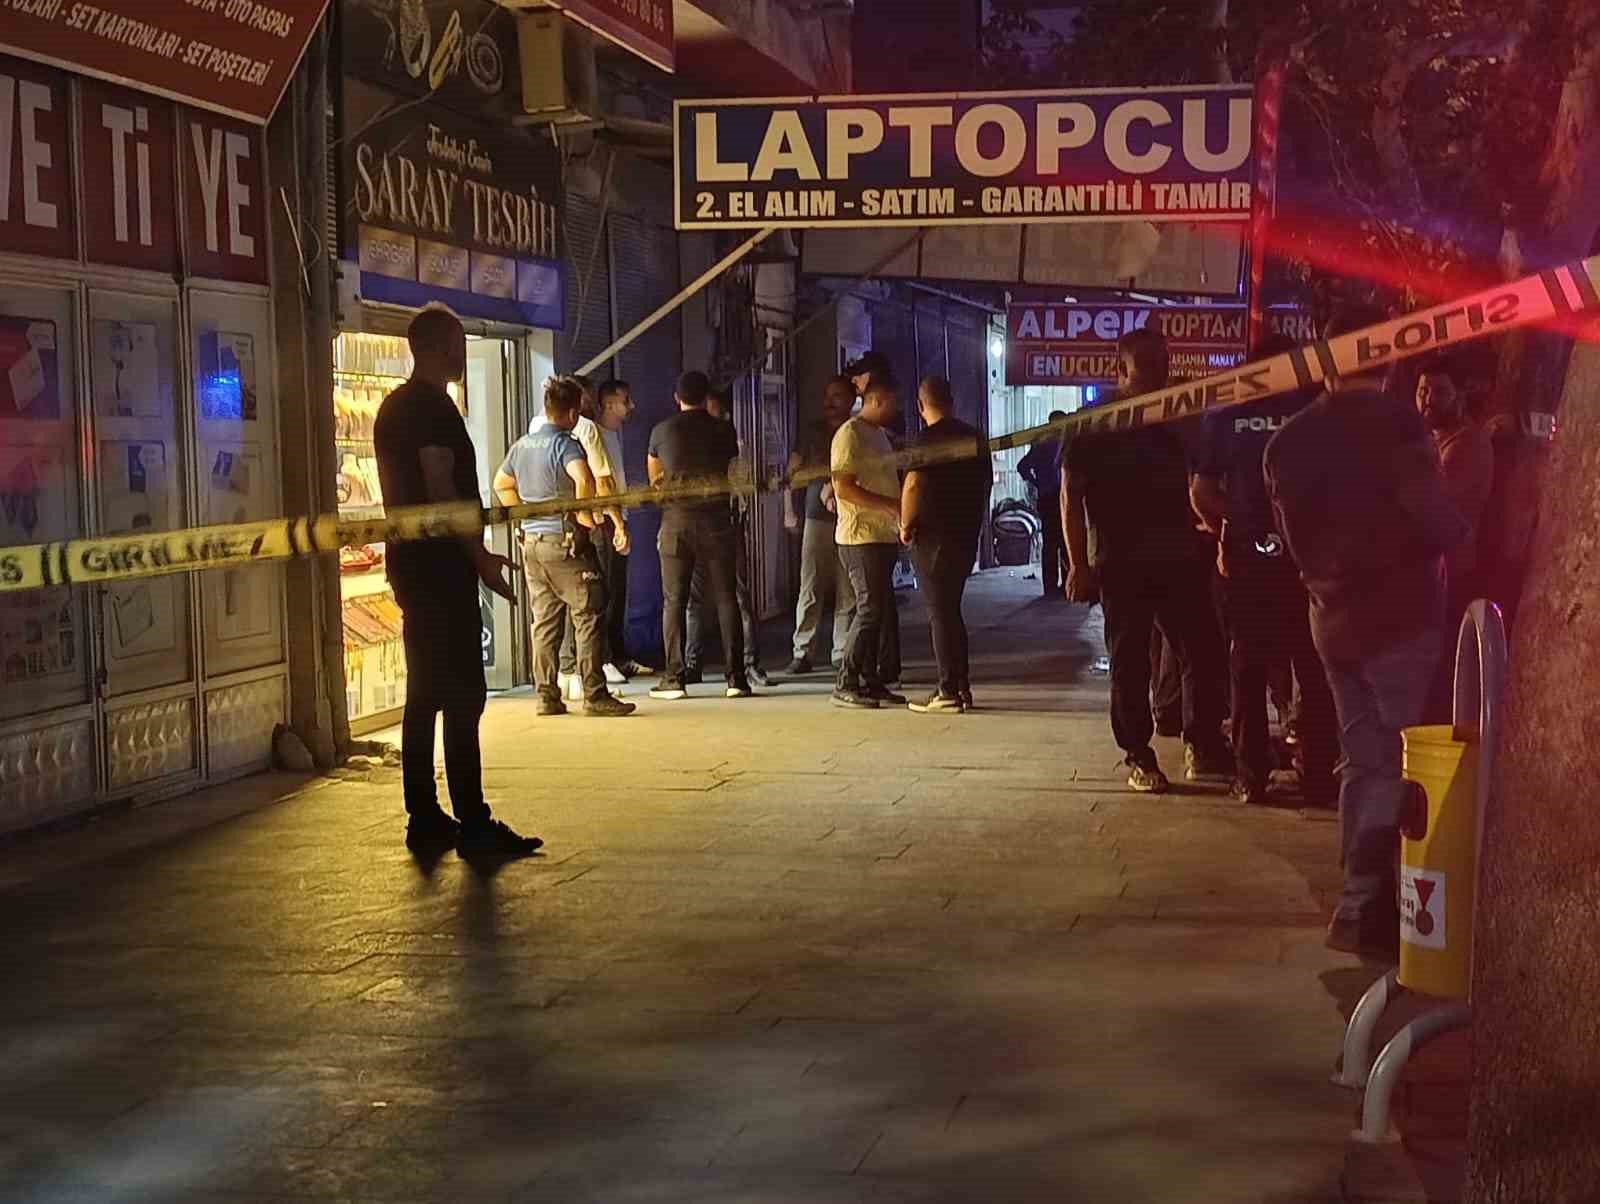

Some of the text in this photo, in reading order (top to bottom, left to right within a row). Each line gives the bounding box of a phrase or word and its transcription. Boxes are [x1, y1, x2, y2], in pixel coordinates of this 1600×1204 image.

[65, 3, 97, 32] SET
[94, 9, 181, 58] KARTONLARI
[182, 40, 210, 66] SET
[205, 45, 275, 86] POŞETLERİ
[248, 3, 295, 38] PASPAS
[695, 97, 1253, 182] LAPTOPCU
[353, 143, 557, 258] SARAY TESBİH
[696, 191, 723, 219] 2.
[729, 191, 759, 218] EL
[764, 189, 836, 217] ALIM
[861, 186, 955, 216] SATIM
[981, 177, 1142, 213] GARANTİLİ
[1150, 176, 1253, 211] TAMİR
[1159, 311, 1243, 338] TOPTAN
